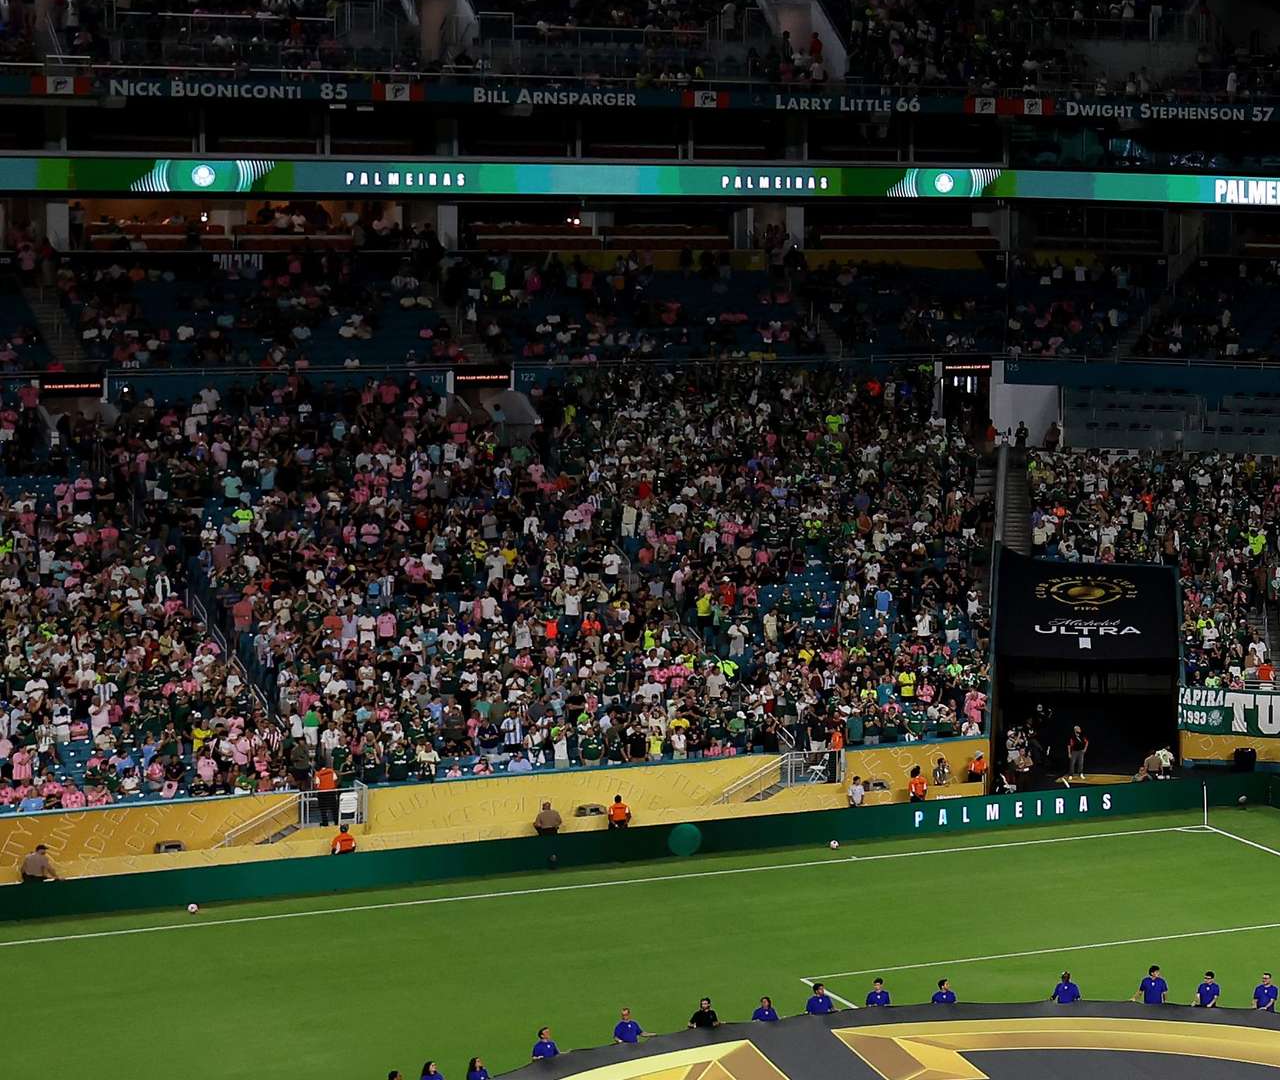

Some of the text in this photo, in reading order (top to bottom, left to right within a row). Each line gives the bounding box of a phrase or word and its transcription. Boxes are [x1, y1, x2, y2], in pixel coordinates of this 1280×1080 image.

[320, 82, 349, 102] 85
[896, 97, 921, 113] 66
[1251, 106, 1274, 122] 57
[346, 171, 466, 188] PALMEIRAS
[722, 175, 829, 190] PALMEIRAS
[1034, 625, 1142, 635] ULTRA
[915, 793, 1112, 828] PALMEIRAS
